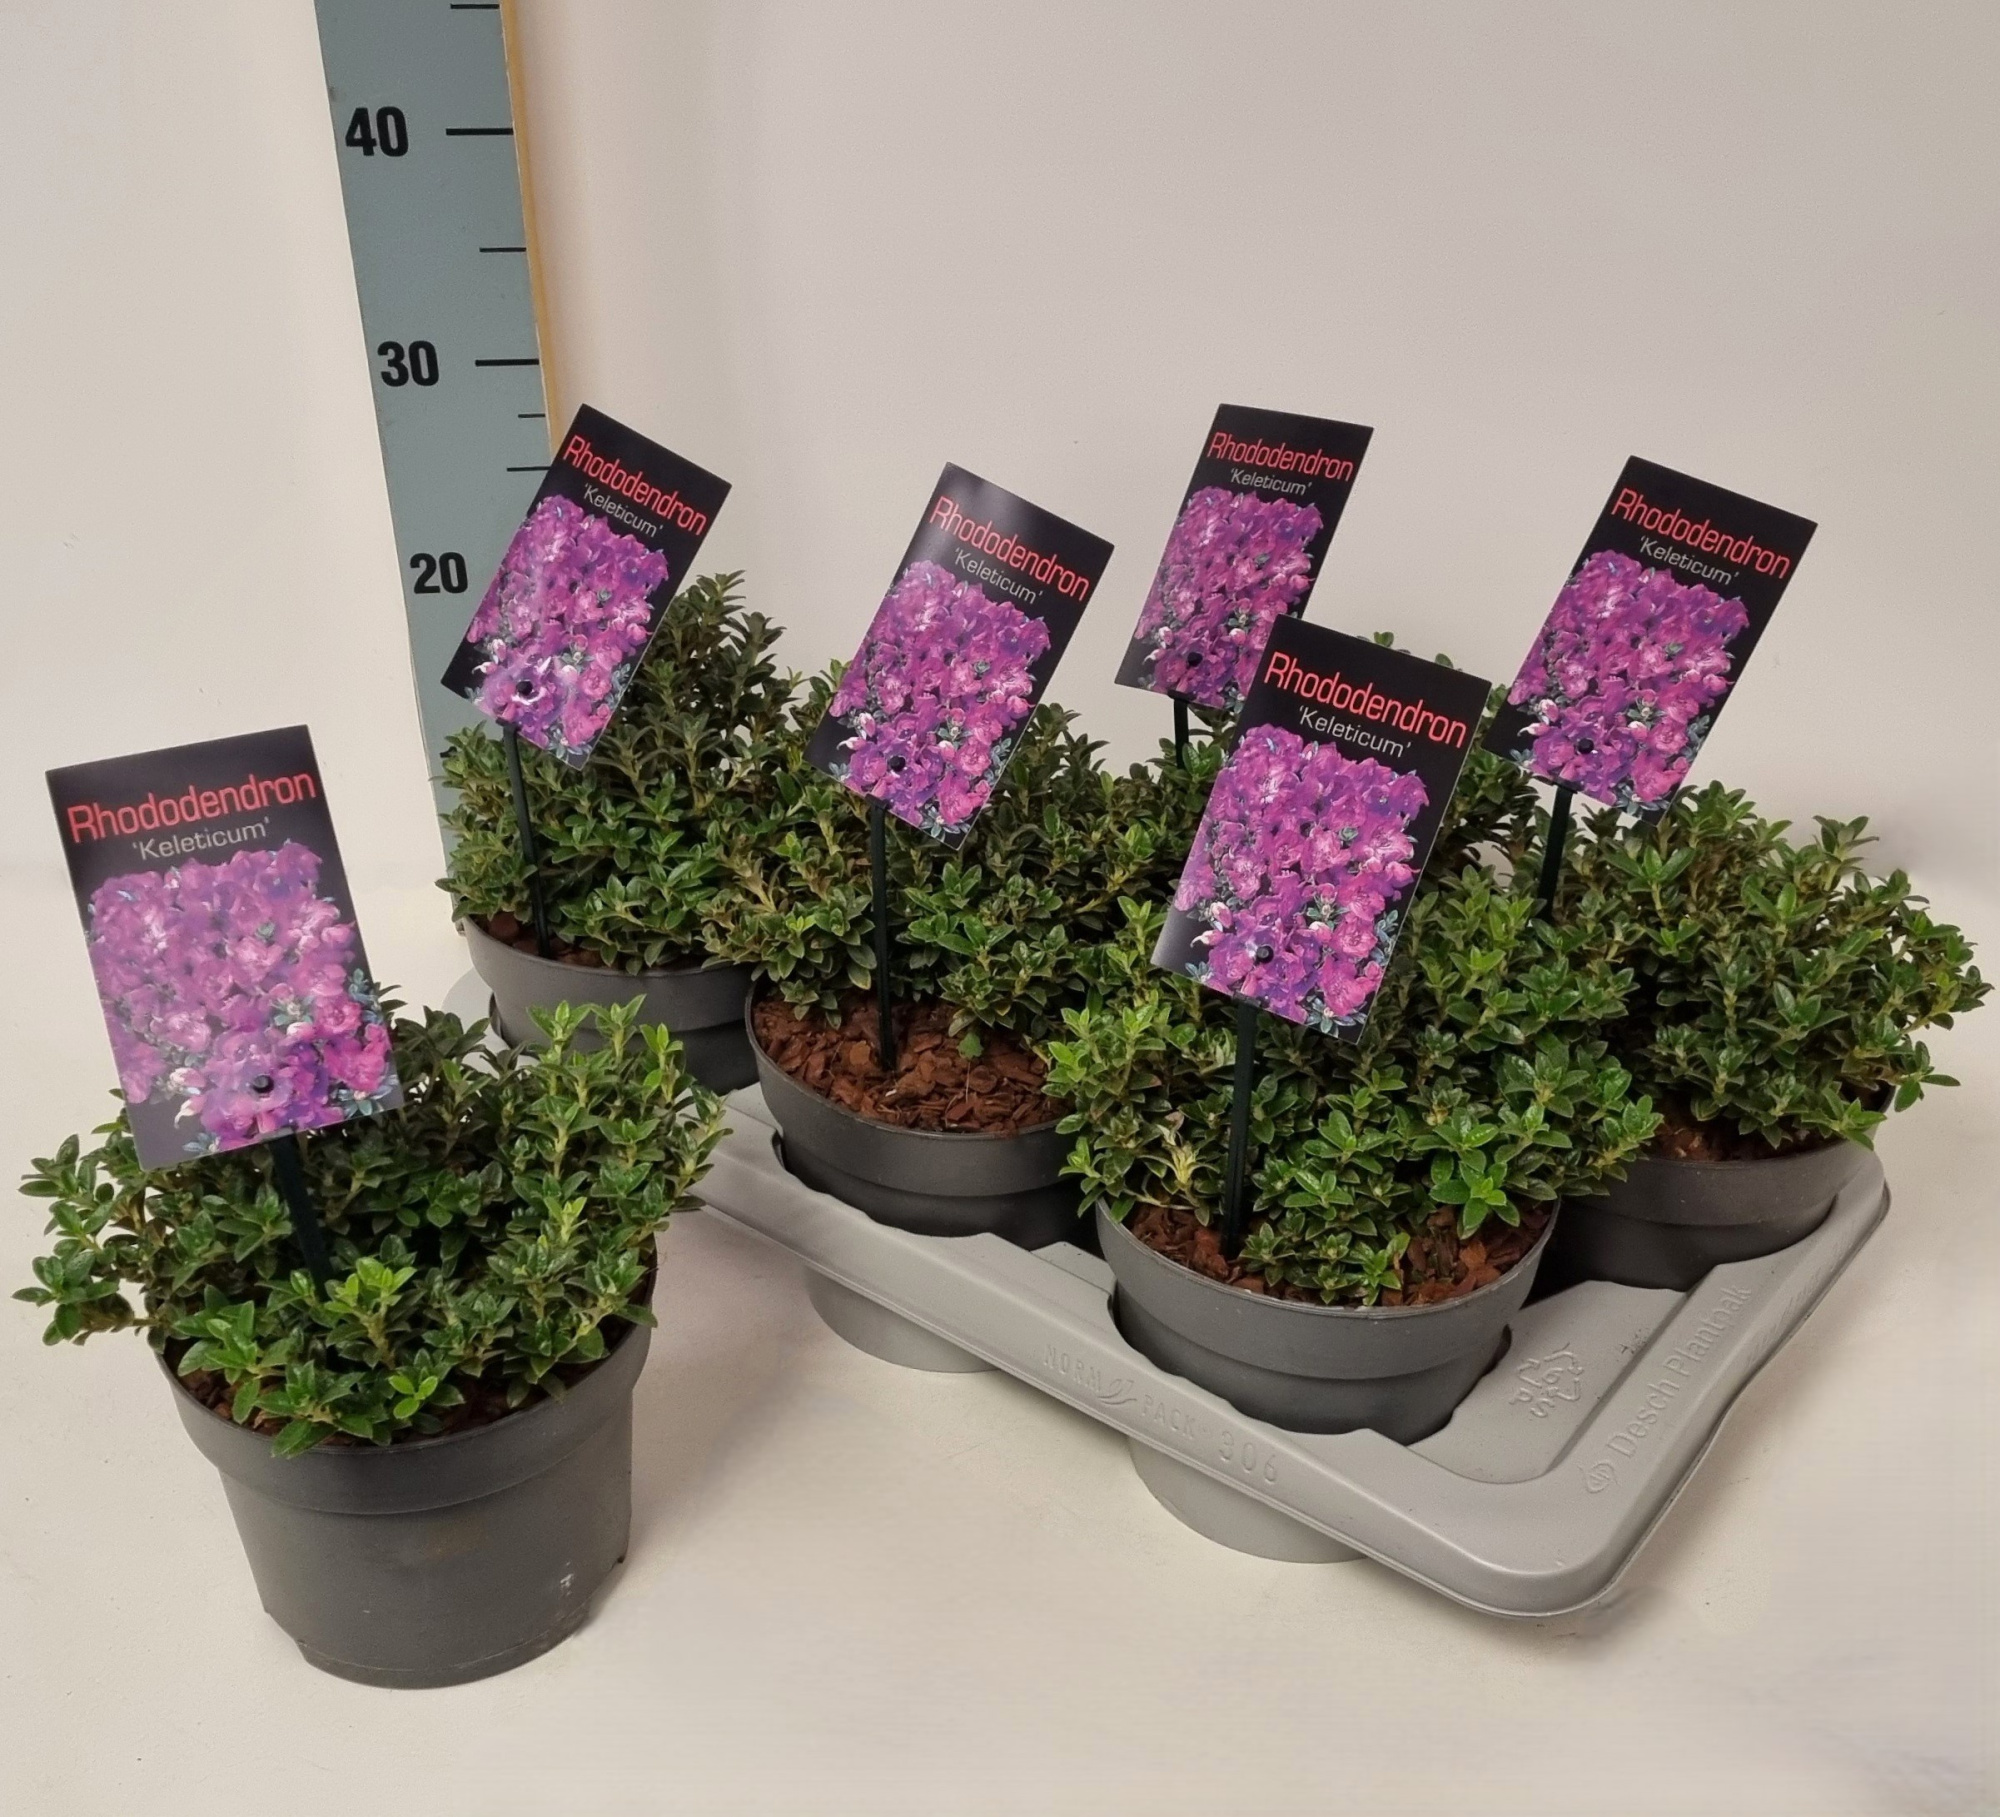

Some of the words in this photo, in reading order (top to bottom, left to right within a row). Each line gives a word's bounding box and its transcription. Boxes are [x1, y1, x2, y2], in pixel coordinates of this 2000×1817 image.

[345, 105, 409, 157] 40
[377, 340, 439, 387] 30
[563, 434, 707, 536] Rhododendron
[1207, 431, 1353, 482] Rhododendron
[929, 495, 1090, 602] Rhododendron
[1611, 487, 1791, 580] Rhododendron
[410, 552, 468, 594] 20
[1263, 651, 1468, 749] Rhododendron
[67, 772, 317, 843] Rhododendron
[1607, 1377, 1682, 1459] Desch
[1216, 1429, 1280, 1485] 306
